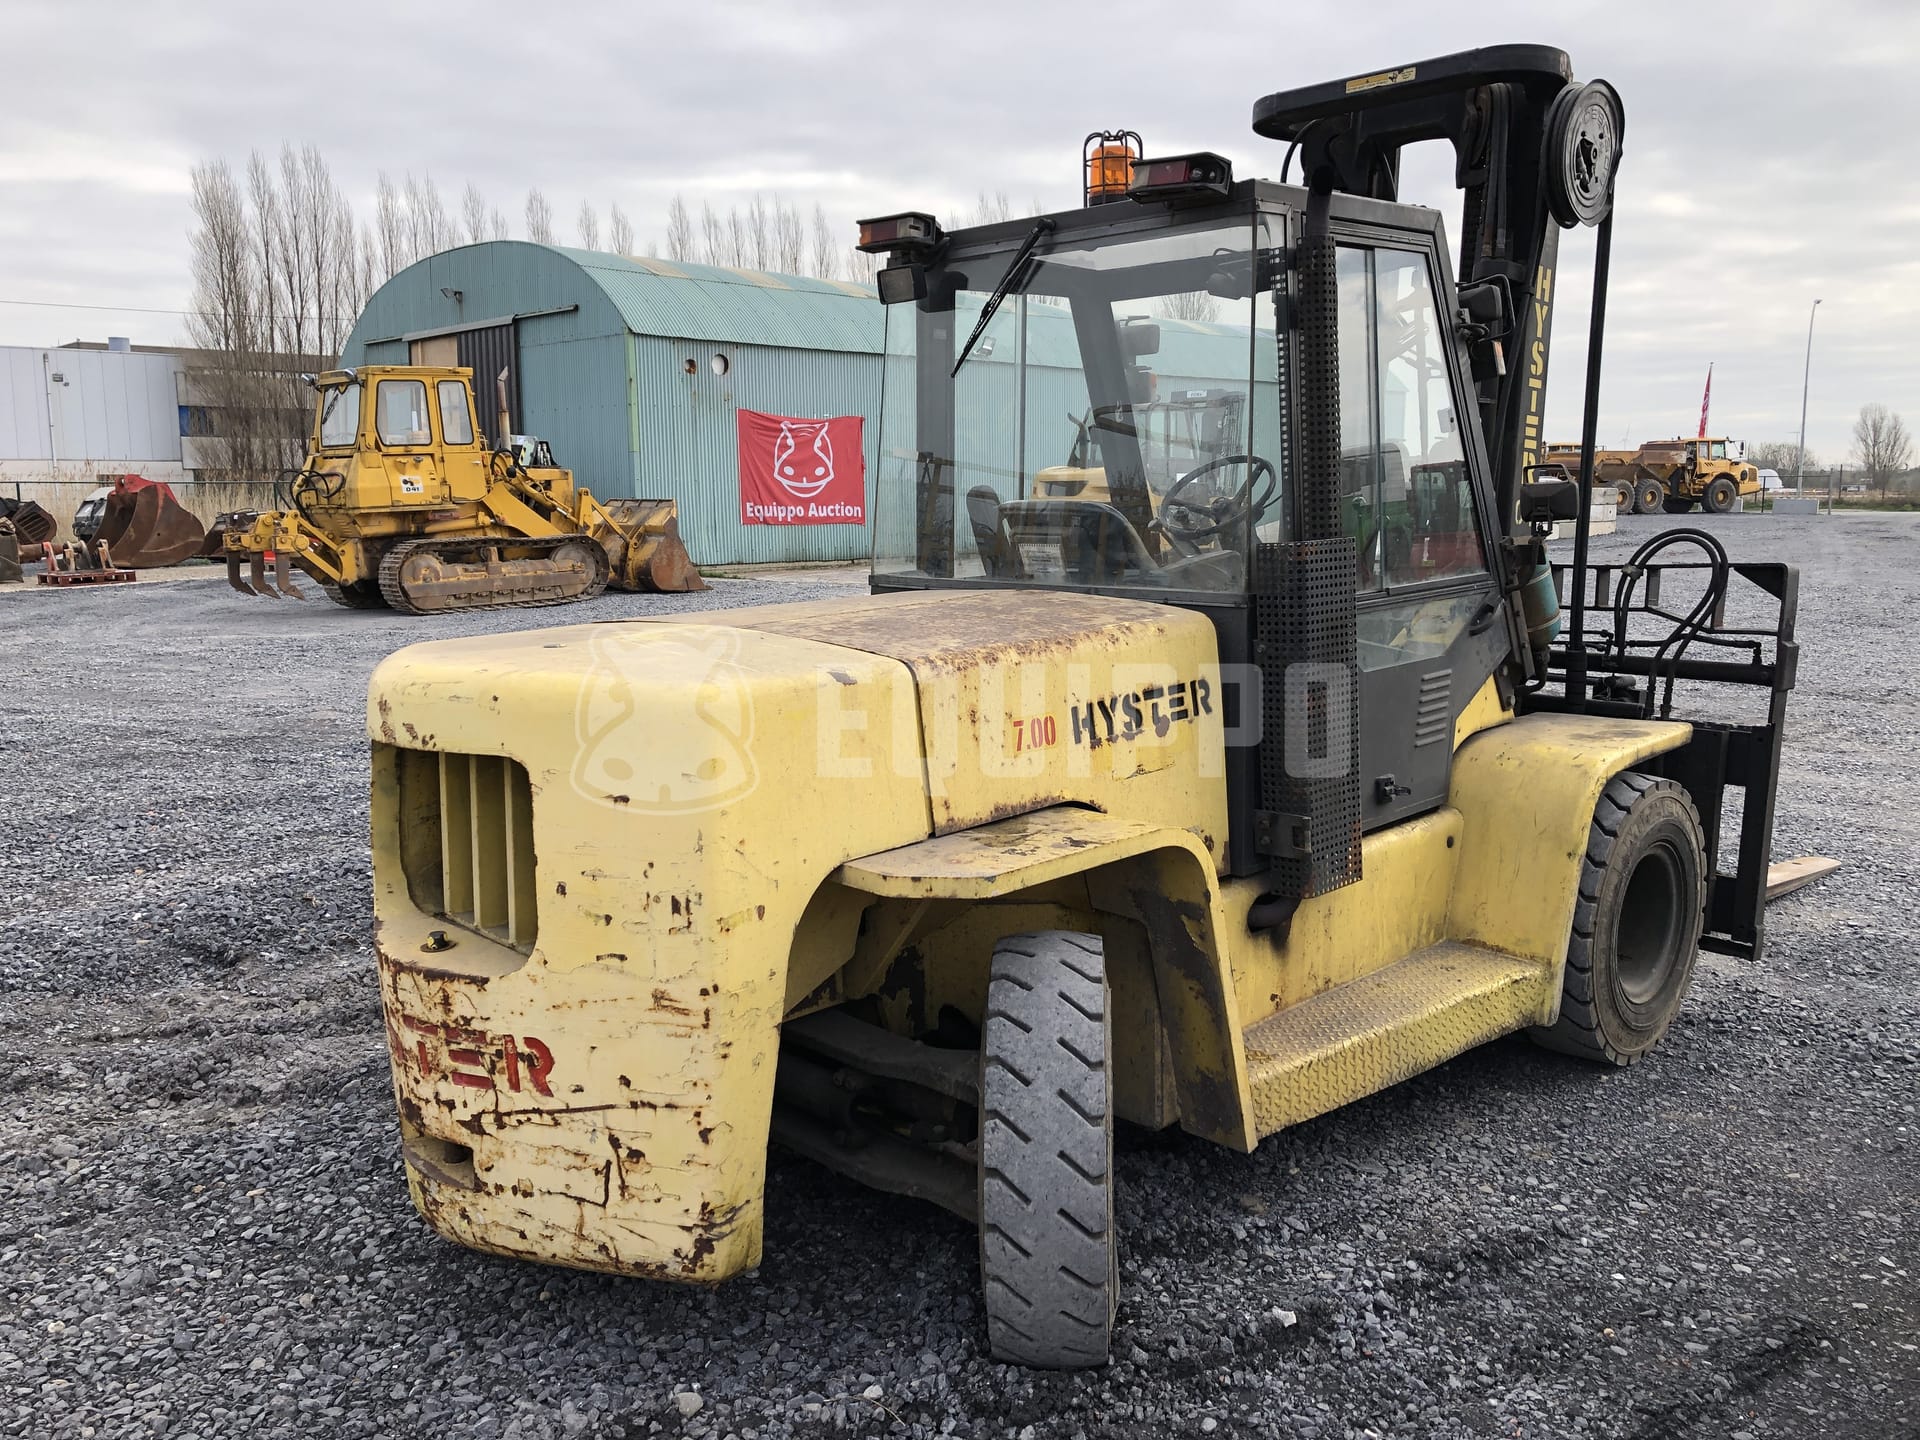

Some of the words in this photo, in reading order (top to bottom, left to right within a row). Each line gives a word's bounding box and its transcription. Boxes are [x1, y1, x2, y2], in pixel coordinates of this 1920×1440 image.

[1521, 265, 1552, 485] HYSTER
[746, 502, 804, 521] Equippo
[808, 502, 861, 517] Auction
[1013, 715, 1056, 752] 7.00
[1070, 679, 1213, 745] HYSTER
